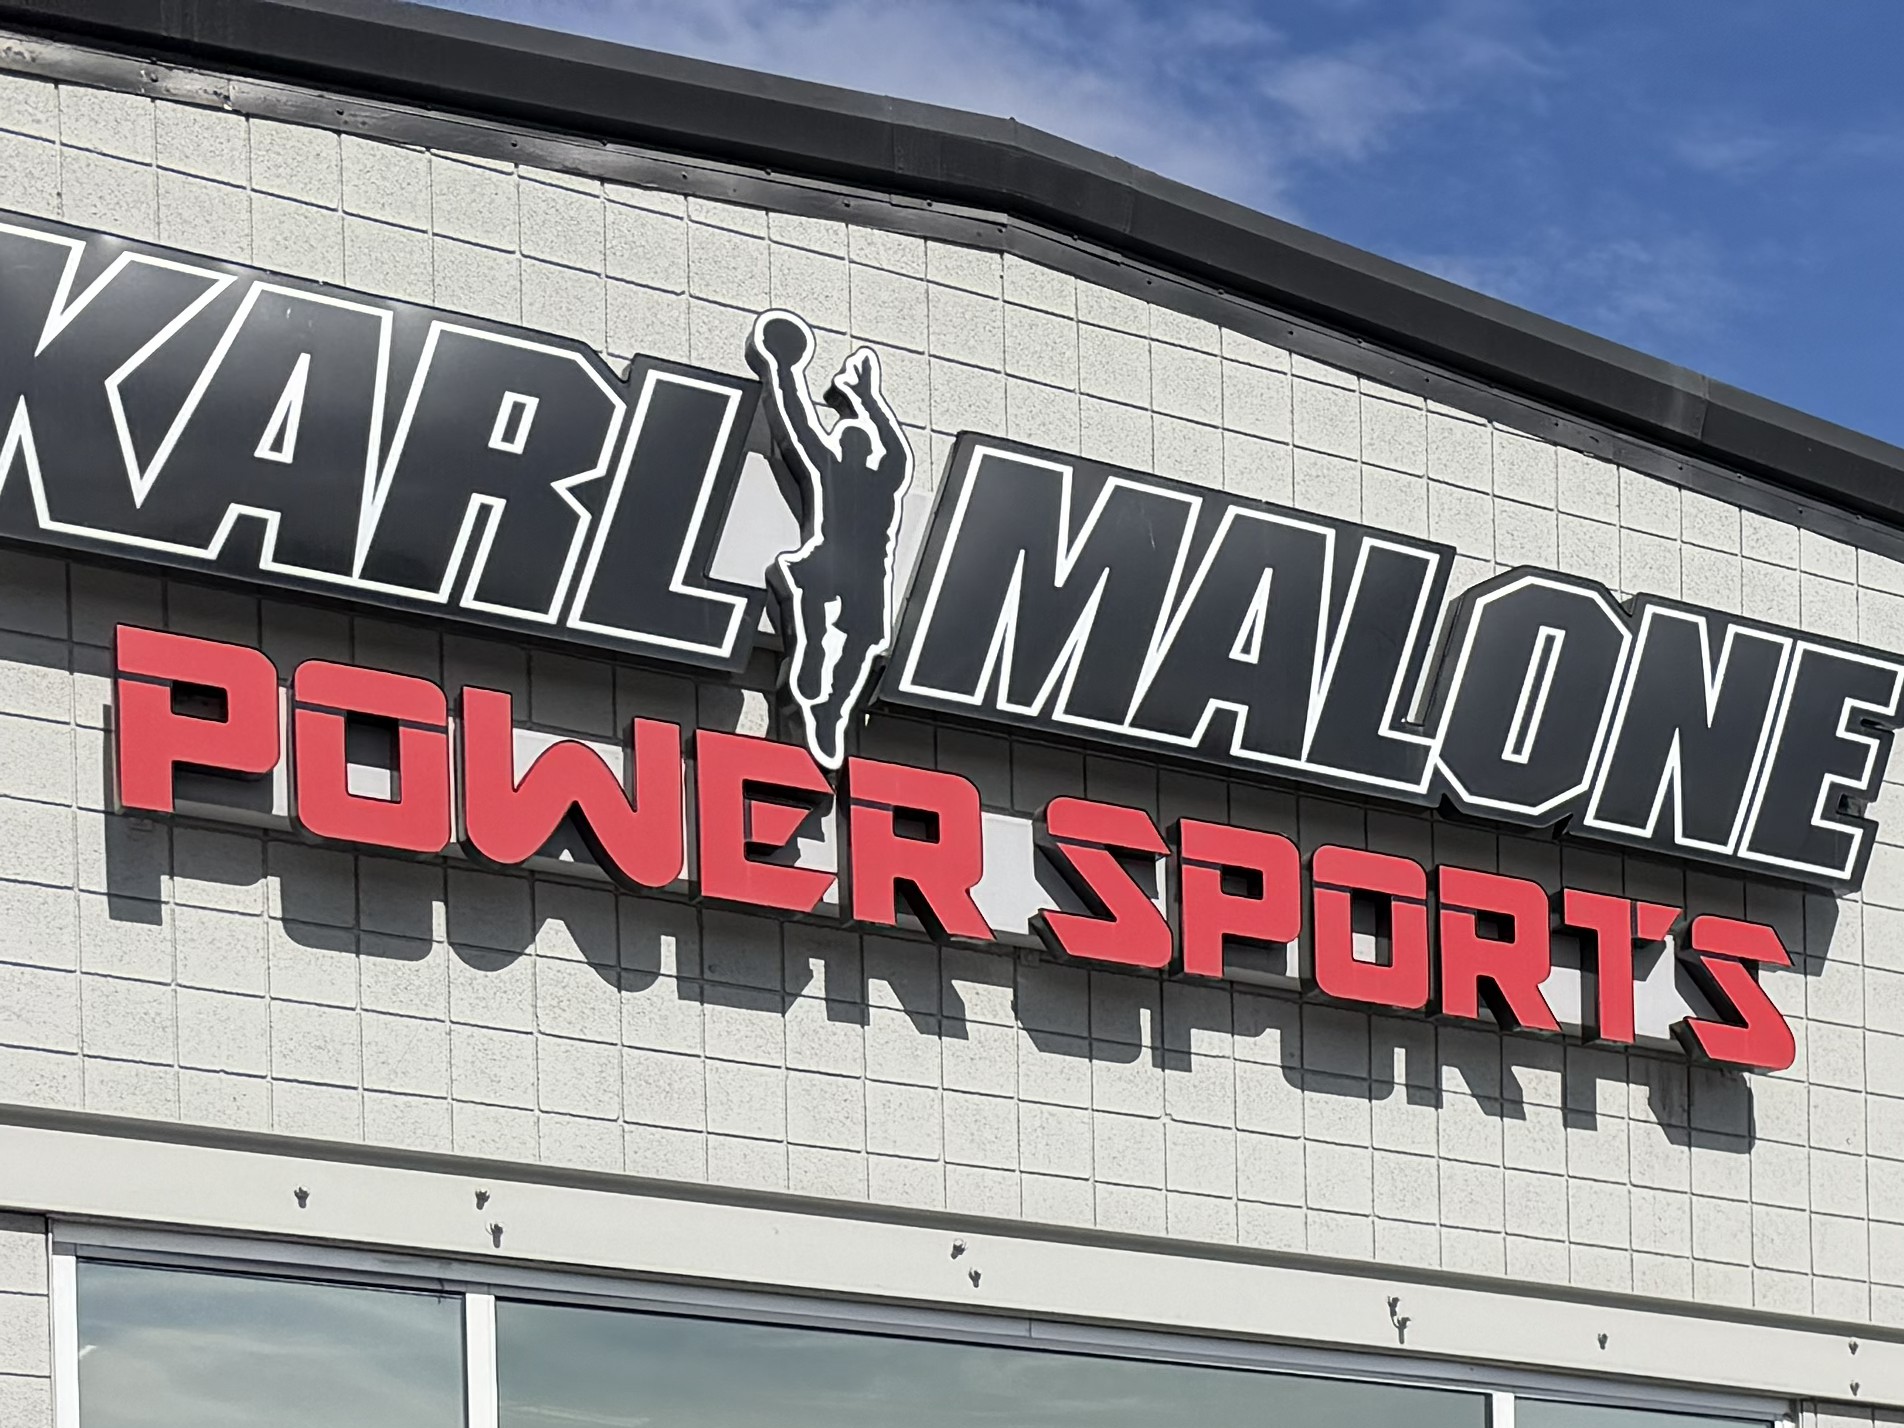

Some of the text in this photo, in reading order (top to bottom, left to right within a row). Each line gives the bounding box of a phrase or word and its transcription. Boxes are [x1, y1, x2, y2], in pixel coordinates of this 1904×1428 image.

[0, 222, 748, 658] KARL
[116, 623, 1796, 1071] POWER SPORTS
